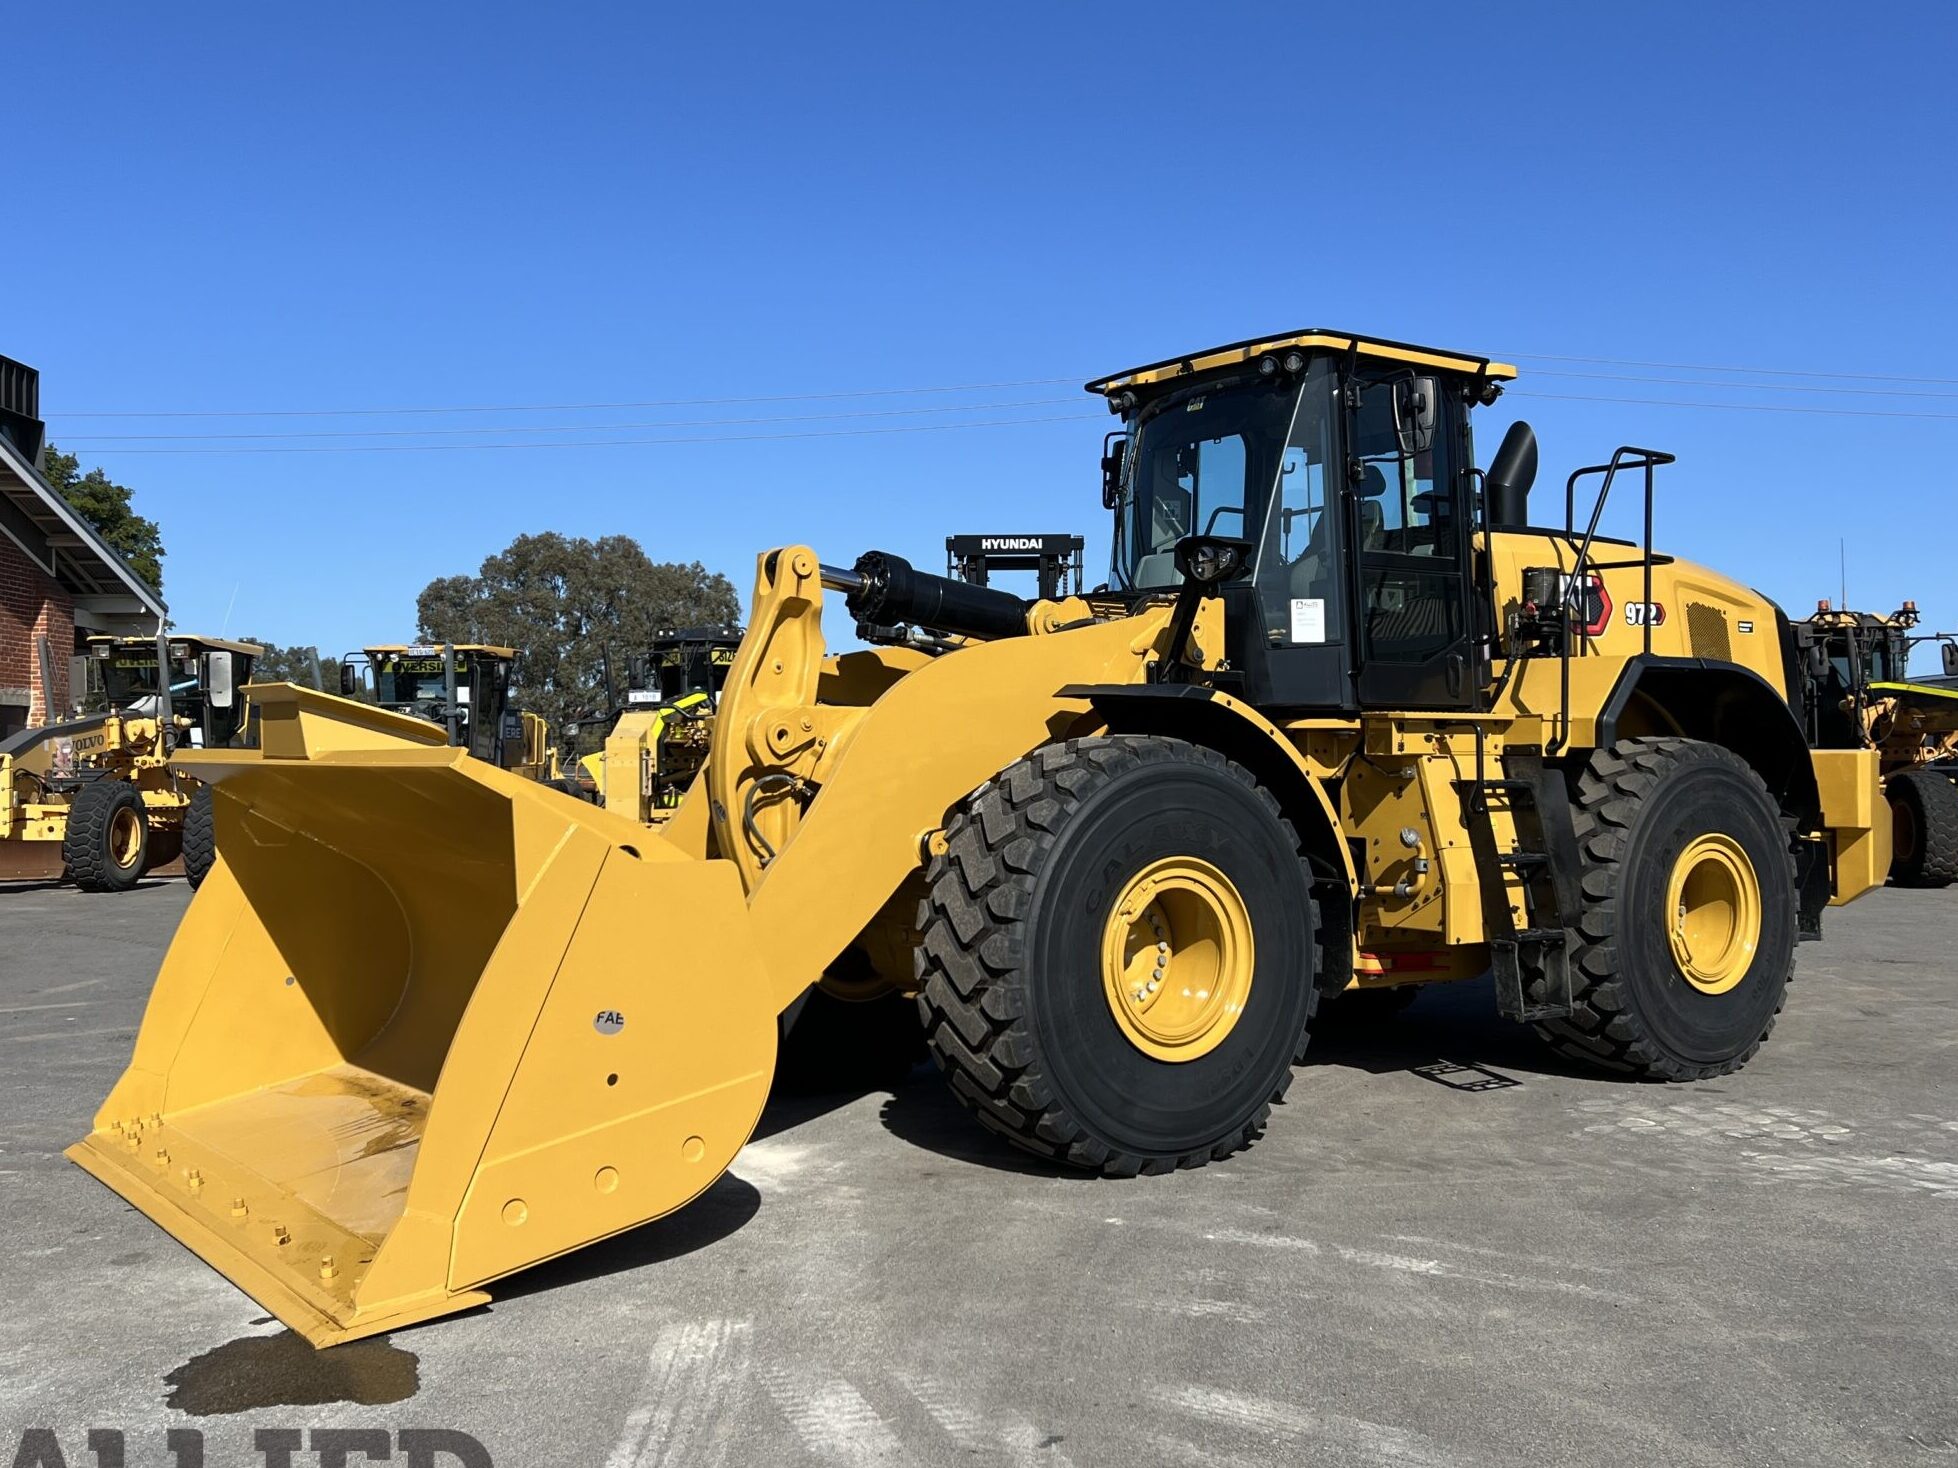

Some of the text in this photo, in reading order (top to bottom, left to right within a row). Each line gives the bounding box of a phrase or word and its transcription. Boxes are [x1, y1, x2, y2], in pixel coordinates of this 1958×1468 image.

[981, 538, 1043, 549] HYUNDAI
[1625, 603, 1657, 625] 972
[505, 727, 521, 739] ERE
